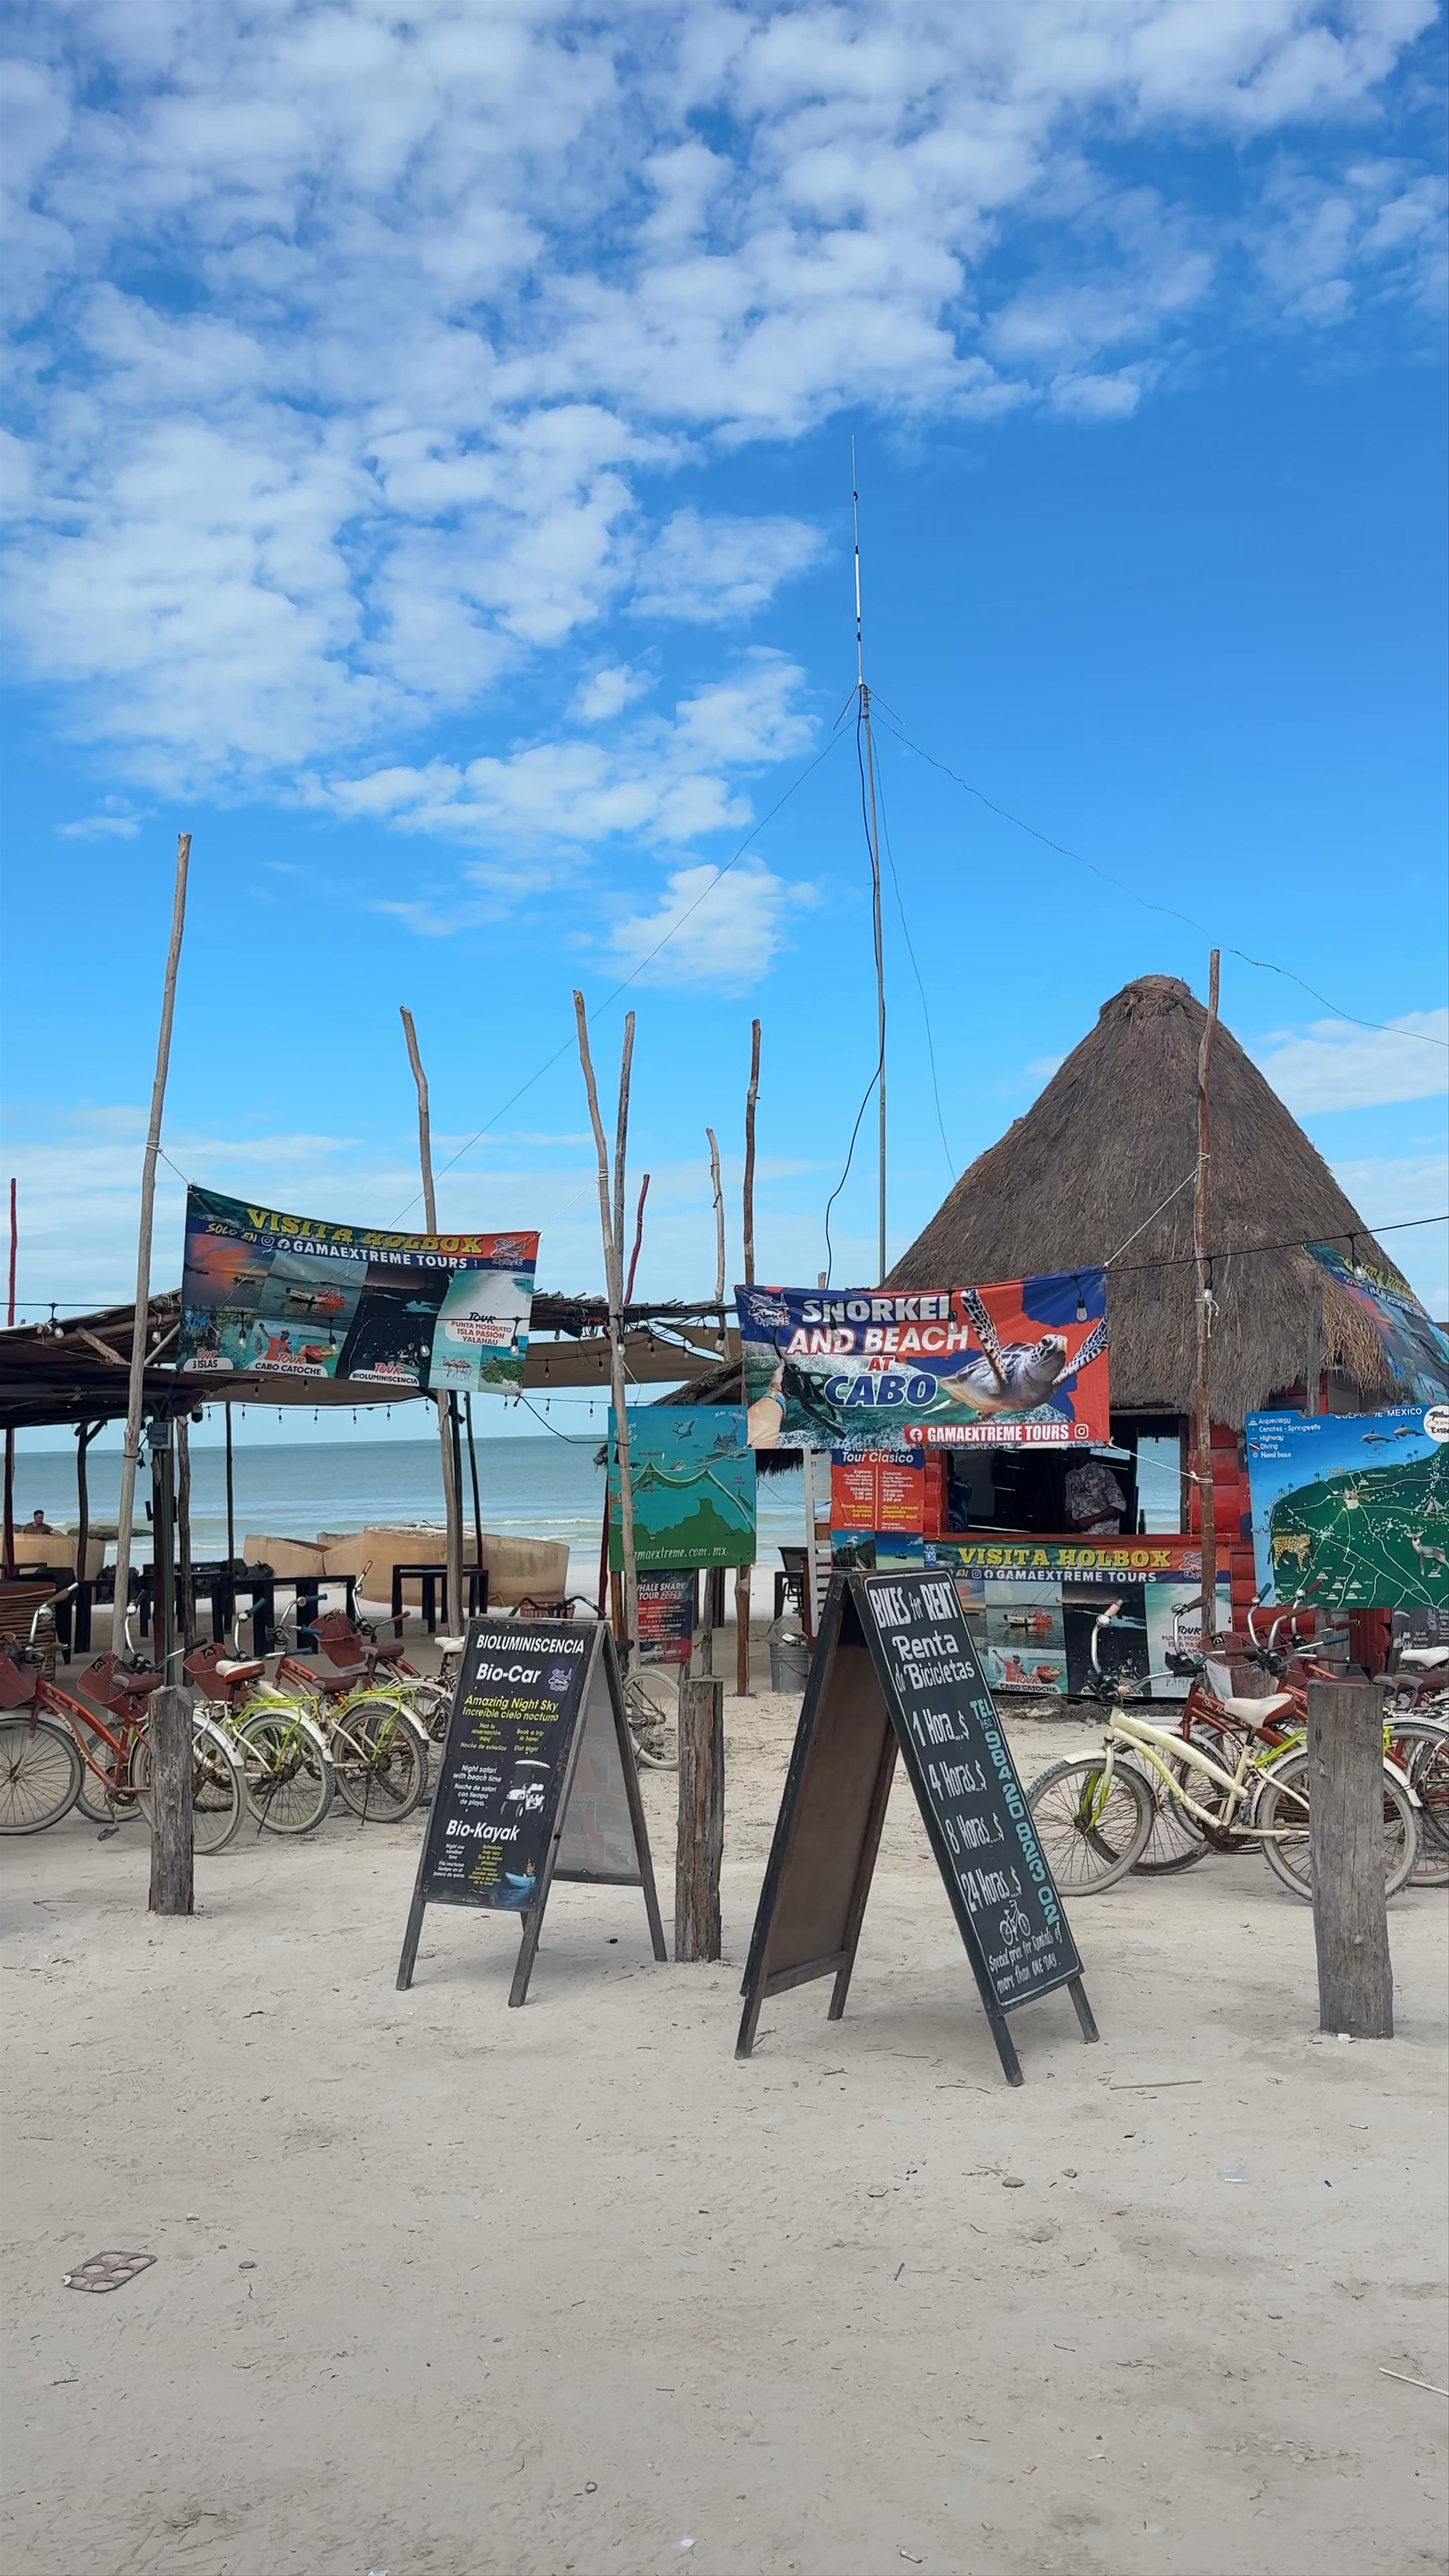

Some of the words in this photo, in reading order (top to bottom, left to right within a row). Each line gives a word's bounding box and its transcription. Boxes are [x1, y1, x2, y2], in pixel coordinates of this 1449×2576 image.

[247, 1208, 354, 1244] VISITA
[364, 1230, 483, 1254] HOLBOX
[206, 1223, 238, 1236] SOLO
[241, 1230, 258, 1243] EN
[294, 1241, 411, 1265] GAMAEXTREME
[416, 1255, 468, 1269] TOURS
[475, 1324, 512, 1333] MOSQUITO
[462, 1335, 498, 1346] YALAHAU
[787, 1327, 855, 1354] AND
[864, 1325, 968, 1353] BEACH
[197, 1348, 218, 1359] TOUR
[277, 1352, 306, 1364] TOUR
[192, 1360, 197, 1369] 3
[197, 1360, 218, 1368] ISLAS
[255, 1363, 280, 1371] CABO
[282, 1365, 321, 1375] CATOCHE
[373, 1362, 404, 1375] TOUR
[867, 1356, 895, 1372] AT
[352, 1373, 417, 1384] BIOLUMINISCENCIA
[824, 1372, 938, 1407] CABO
[1387, 1408, 1422, 1417] MEXICO
[928, 1426, 1023, 1442] GAMAEXTREME
[1025, 1424, 1068, 1440] TOURS
[843, 1452, 866, 1463] Tour
[869, 1452, 913, 1463] Clasico
[958, 1548, 1050, 1566] VISITA
[1059, 1549, 1172, 1568] HOLBOX
[956, 1569, 969, 1577] EN
[996, 1570, 1102, 1582] GAMAEXTREME
[1108, 1572, 1157, 1582] TOURS
[869, 1587, 911, 1629] BIKES
[908, 1592, 924, 1621] for
[919, 1582, 958, 1621] RENT
[476, 1634, 584, 1653] BIOLUMINISCENCIA
[892, 1630, 960, 1661] Renta
[476, 1663, 542, 1683] Bio-Car
[903, 1659, 975, 1690] Bicicletas
[464, 1695, 509, 1710] Amazing
[511, 1698, 539, 1711] Night
[540, 1700, 558, 1713] Sky
[969, 1698, 993, 1720] TEL
[501, 1710, 521, 1719] cielo
[523, 1712, 559, 1722] nocturno
[913, 1711, 927, 1747] 1
[461, 1764, 478, 1773] Night
[928, 1764, 944, 1801] 4
[446, 1819, 520, 1842] Bio-Kayak
[945, 1819, 960, 1854] 8
[961, 1871, 983, 1913] 24
[989, 1947, 1009, 1974] Special
[1009, 1945, 1022, 1966] price
[1022, 1941, 1032, 1959] for
[1031, 1926, 1054, 1952] Rentals
[1055, 1921, 1062, 1944] of
[997, 1975, 1015, 1994] more
[1015, 1965, 1031, 1984] than
[1031, 1958, 1044, 1976] ONE
